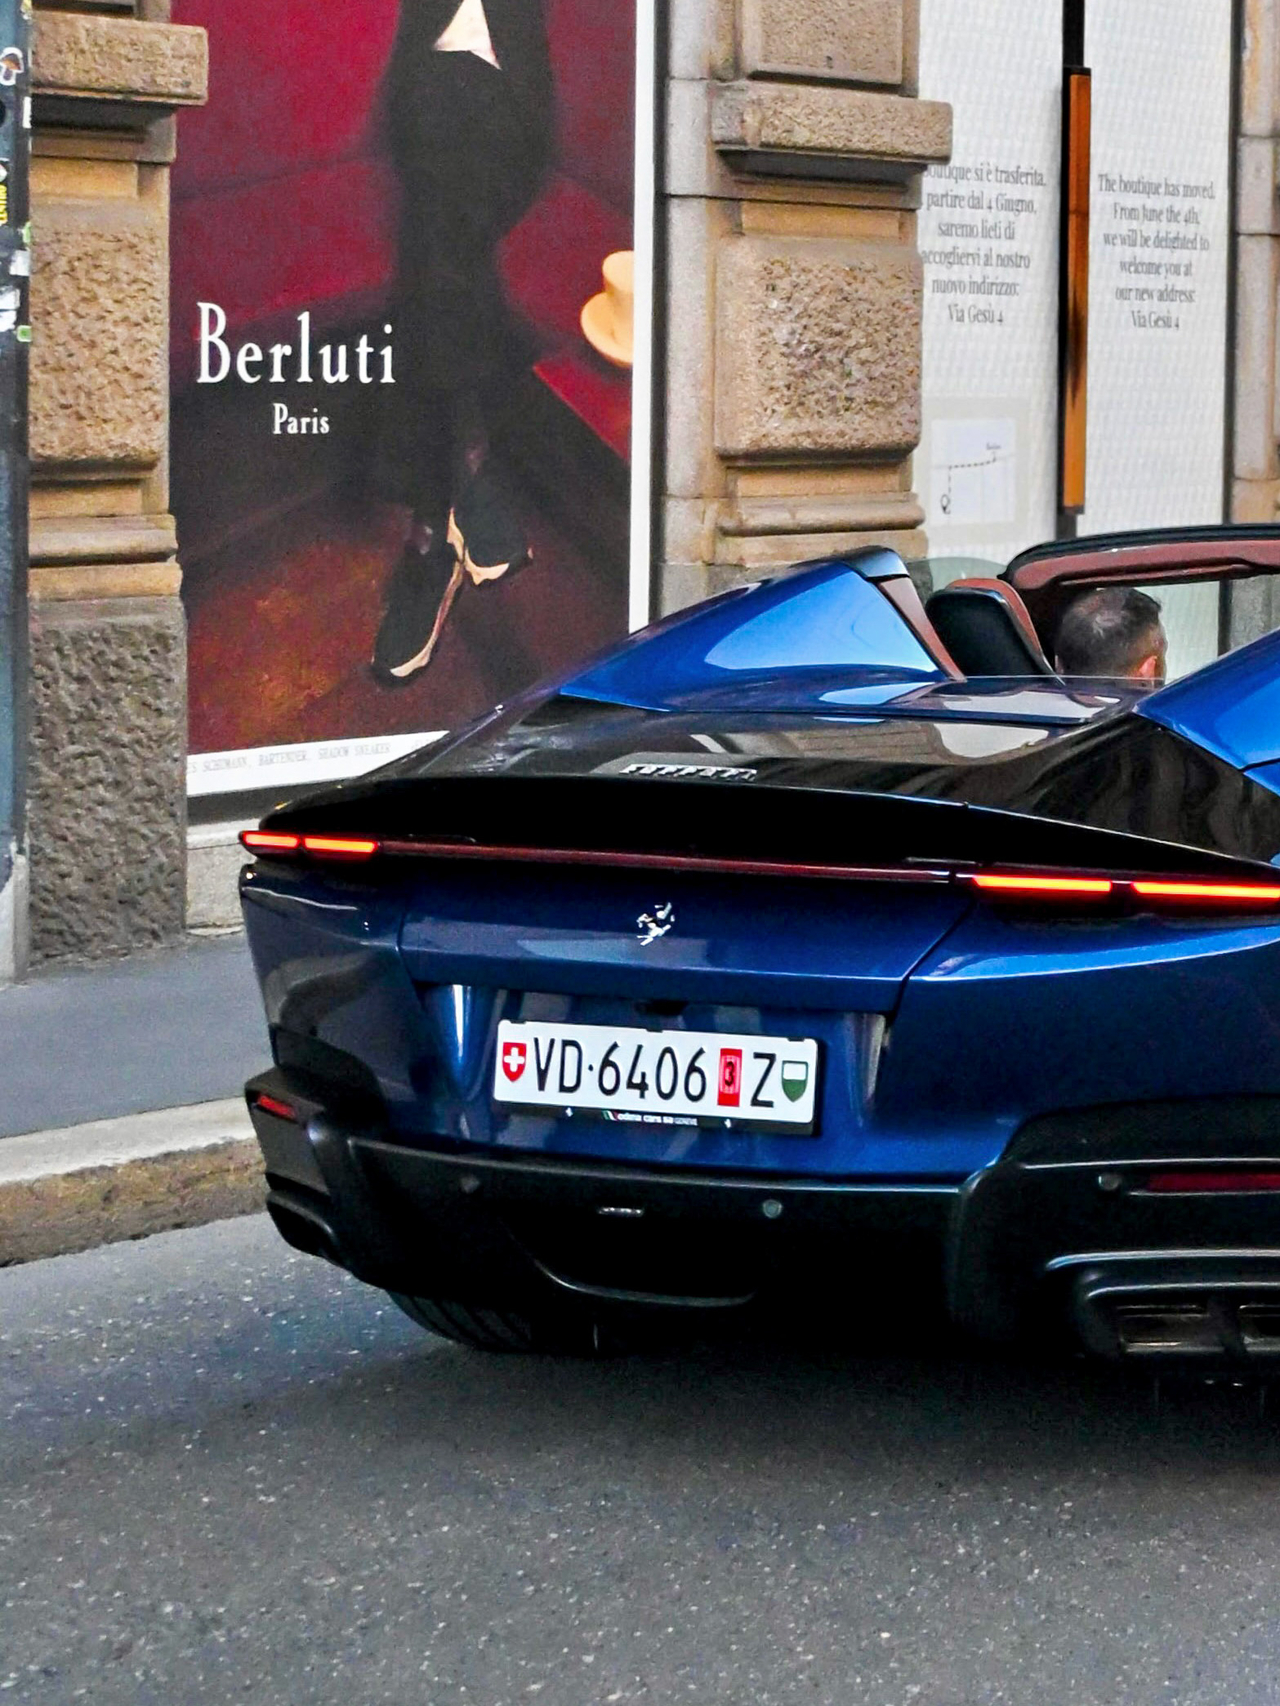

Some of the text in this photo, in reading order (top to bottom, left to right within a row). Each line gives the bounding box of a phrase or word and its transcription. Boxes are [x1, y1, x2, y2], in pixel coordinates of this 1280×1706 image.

[974, 162, 984, 182] si
[986, 162, 992, 182] è
[995, 165, 1047, 186] trasferita.
[1098, 174, 1216, 200] The boutique has moved.
[926, 189, 1037, 217] partire dal 4 Giugno,
[1114, 202, 1140, 221] From
[1142, 204, 1164, 224] June
[1166, 205, 1181, 223] the
[938, 219, 1015, 240] saremo lieti di
[1103, 229, 1210, 253] we will be delighted to
[922, 246, 1031, 270] accogliervi al nostro
[1120, 255, 1193, 279] welcome you at
[932, 274, 1020, 297] nuovo indirizzo:
[1115, 287, 1133, 301] our
[1135, 287, 1154, 301] new
[948, 303, 1003, 325] Via Gesù 4
[1131, 310, 1147, 328] Via
[1174, 317, 1180, 330] 4
[197, 302, 396, 384] Berluti
[273, 402, 330, 435] Paris
[750, 1052, 777, 1108] Z
